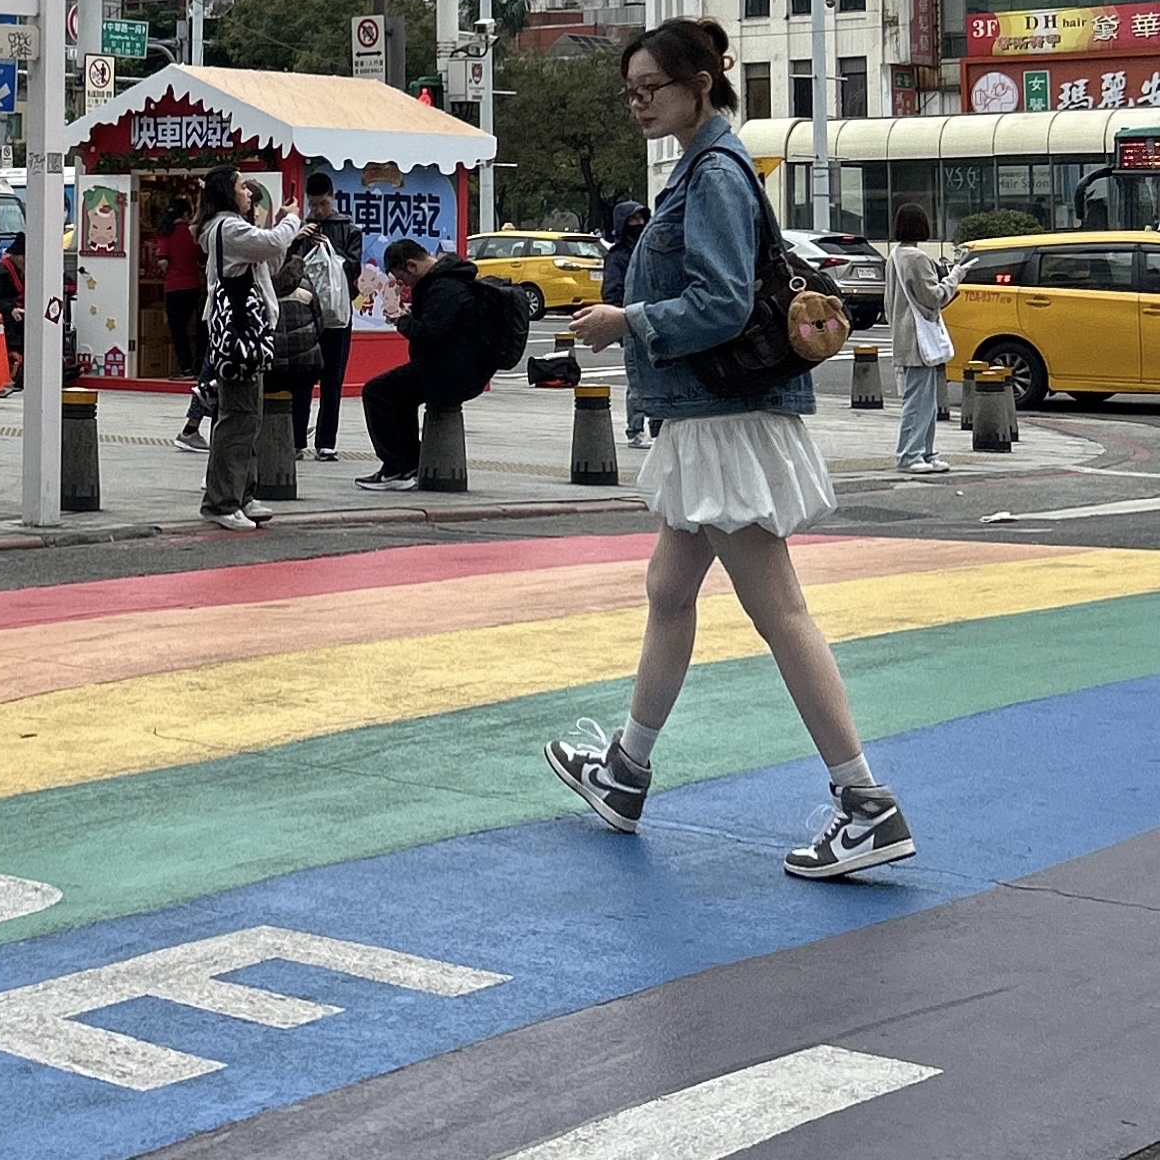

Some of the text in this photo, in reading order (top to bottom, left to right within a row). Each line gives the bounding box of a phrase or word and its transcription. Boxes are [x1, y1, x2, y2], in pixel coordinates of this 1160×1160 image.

[972, 18, 998, 39] 3F
[1062, 17, 1087, 29] hair
[131, 114, 234, 150] 快車肉乾
